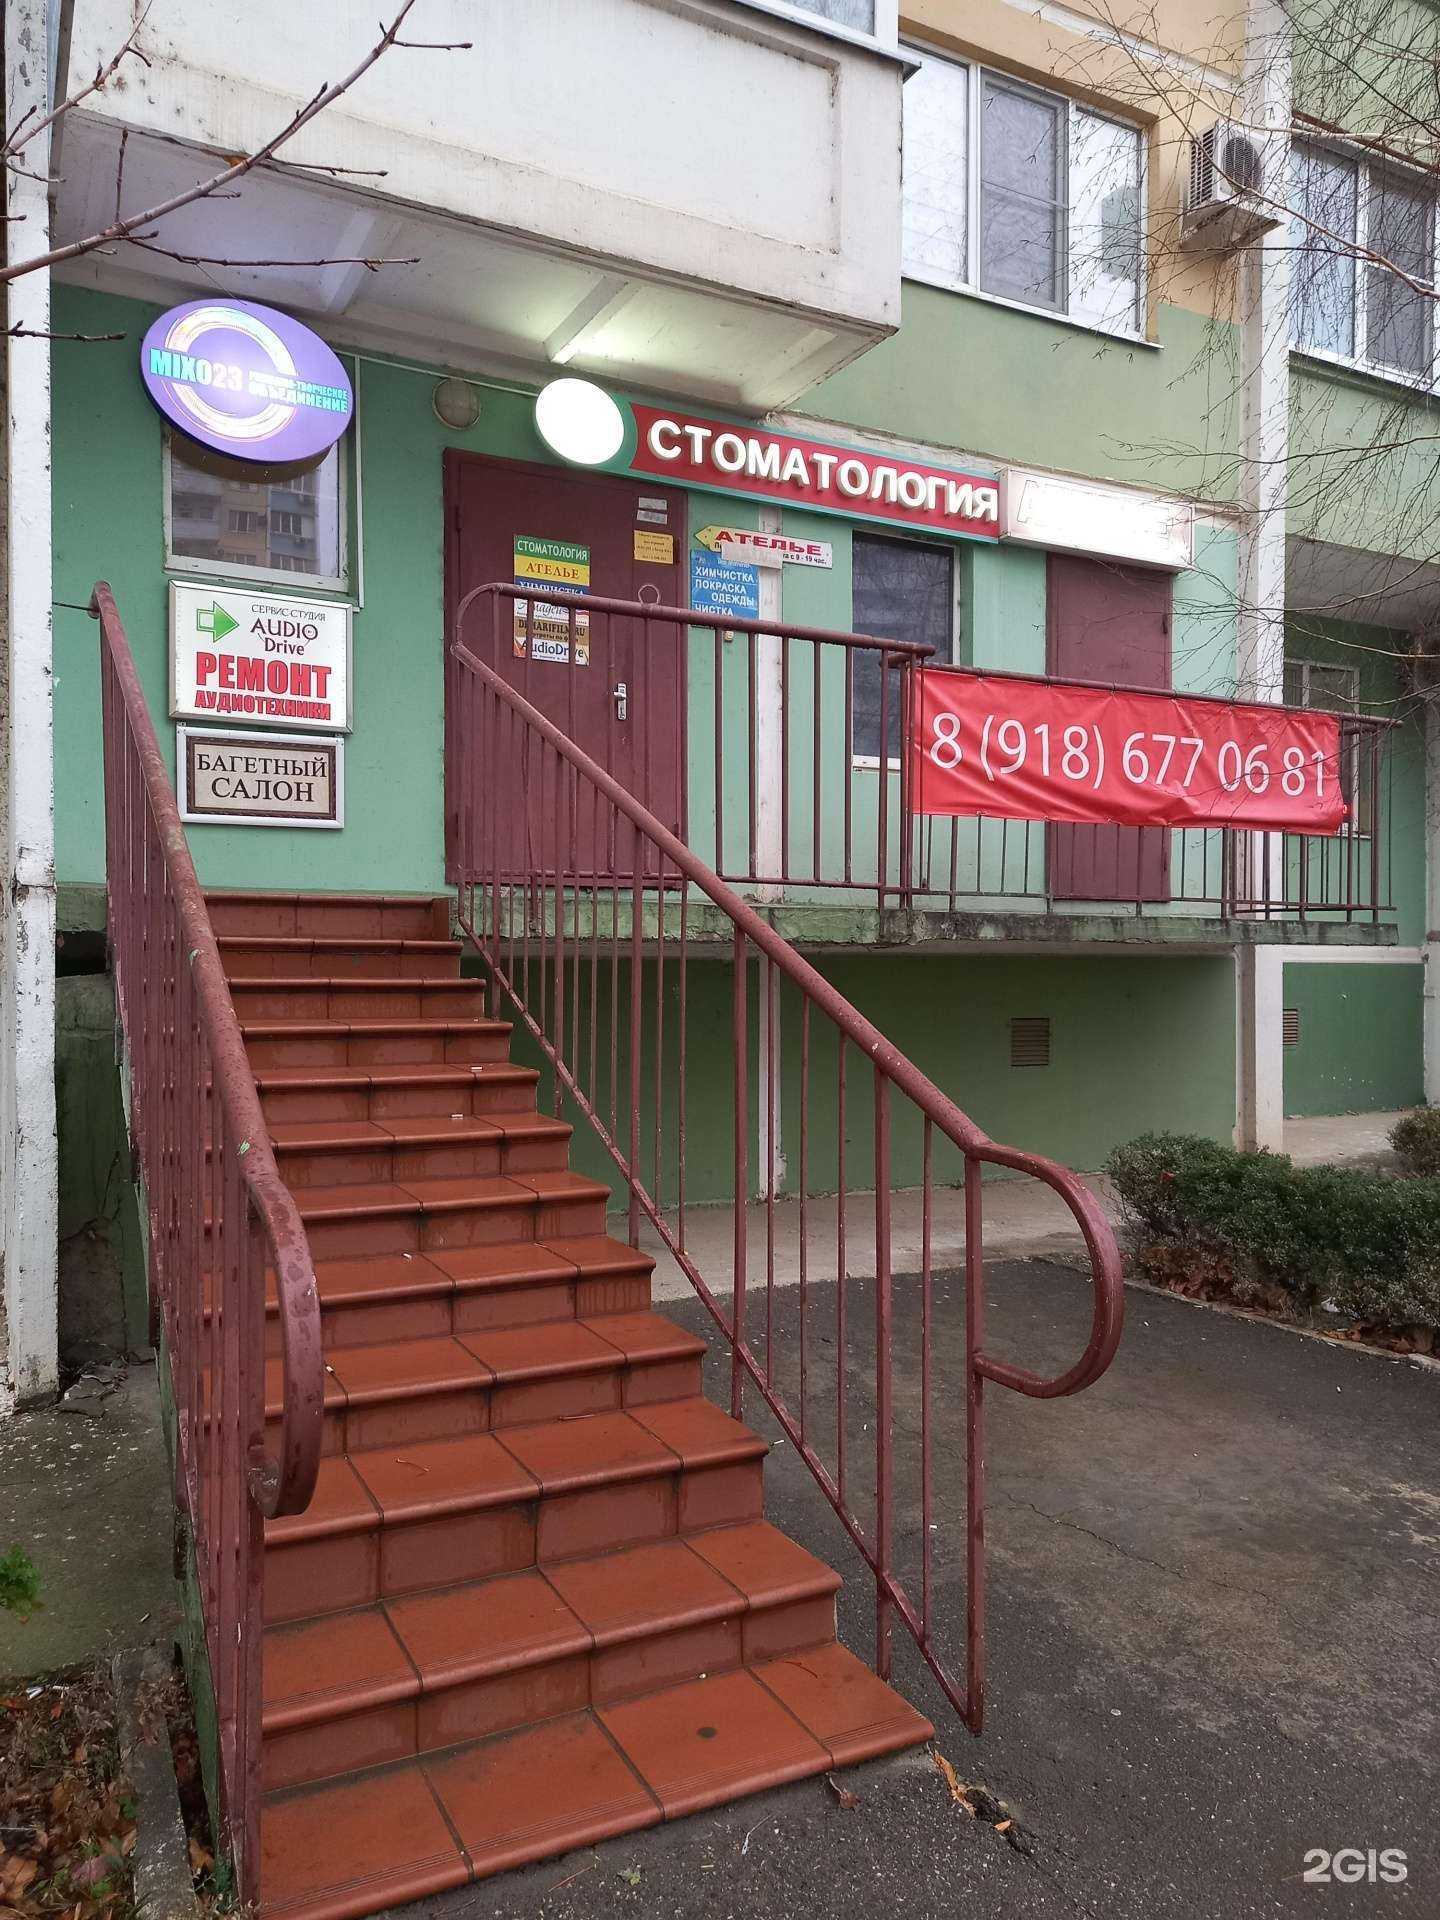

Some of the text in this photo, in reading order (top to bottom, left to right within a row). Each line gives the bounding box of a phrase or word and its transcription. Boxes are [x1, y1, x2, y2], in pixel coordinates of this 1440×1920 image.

[648, 419, 998, 522] СТОМАТОЛОГИЯ
[517, 540, 587, 560] СТОМАТОЛОГИЯ
[715, 530, 822, 556] АТЕЛЬЕ
[526, 561, 580, 578] АТЕЛЬЕ
[695, 566, 754, 583] ХИМЧИСТКА
[695, 579, 747, 595] ПОКРАСКА
[695, 604, 735, 617] ЧИСТКА
[711, 592, 754, 608] ОДЕЖДЫ
[250, 618, 319, 641] AUDIO
[264, 637, 305, 656] Drive
[196, 651, 332, 699] РЕМОНТ
[194, 690, 331, 721] АУДИОТЕХНИКИ
[196, 754, 328, 778] БАГЕТНЫЙ
[930, 712, 1325, 797] 8 (918) 677 06 81
[211, 778, 315, 802] САЛОН
